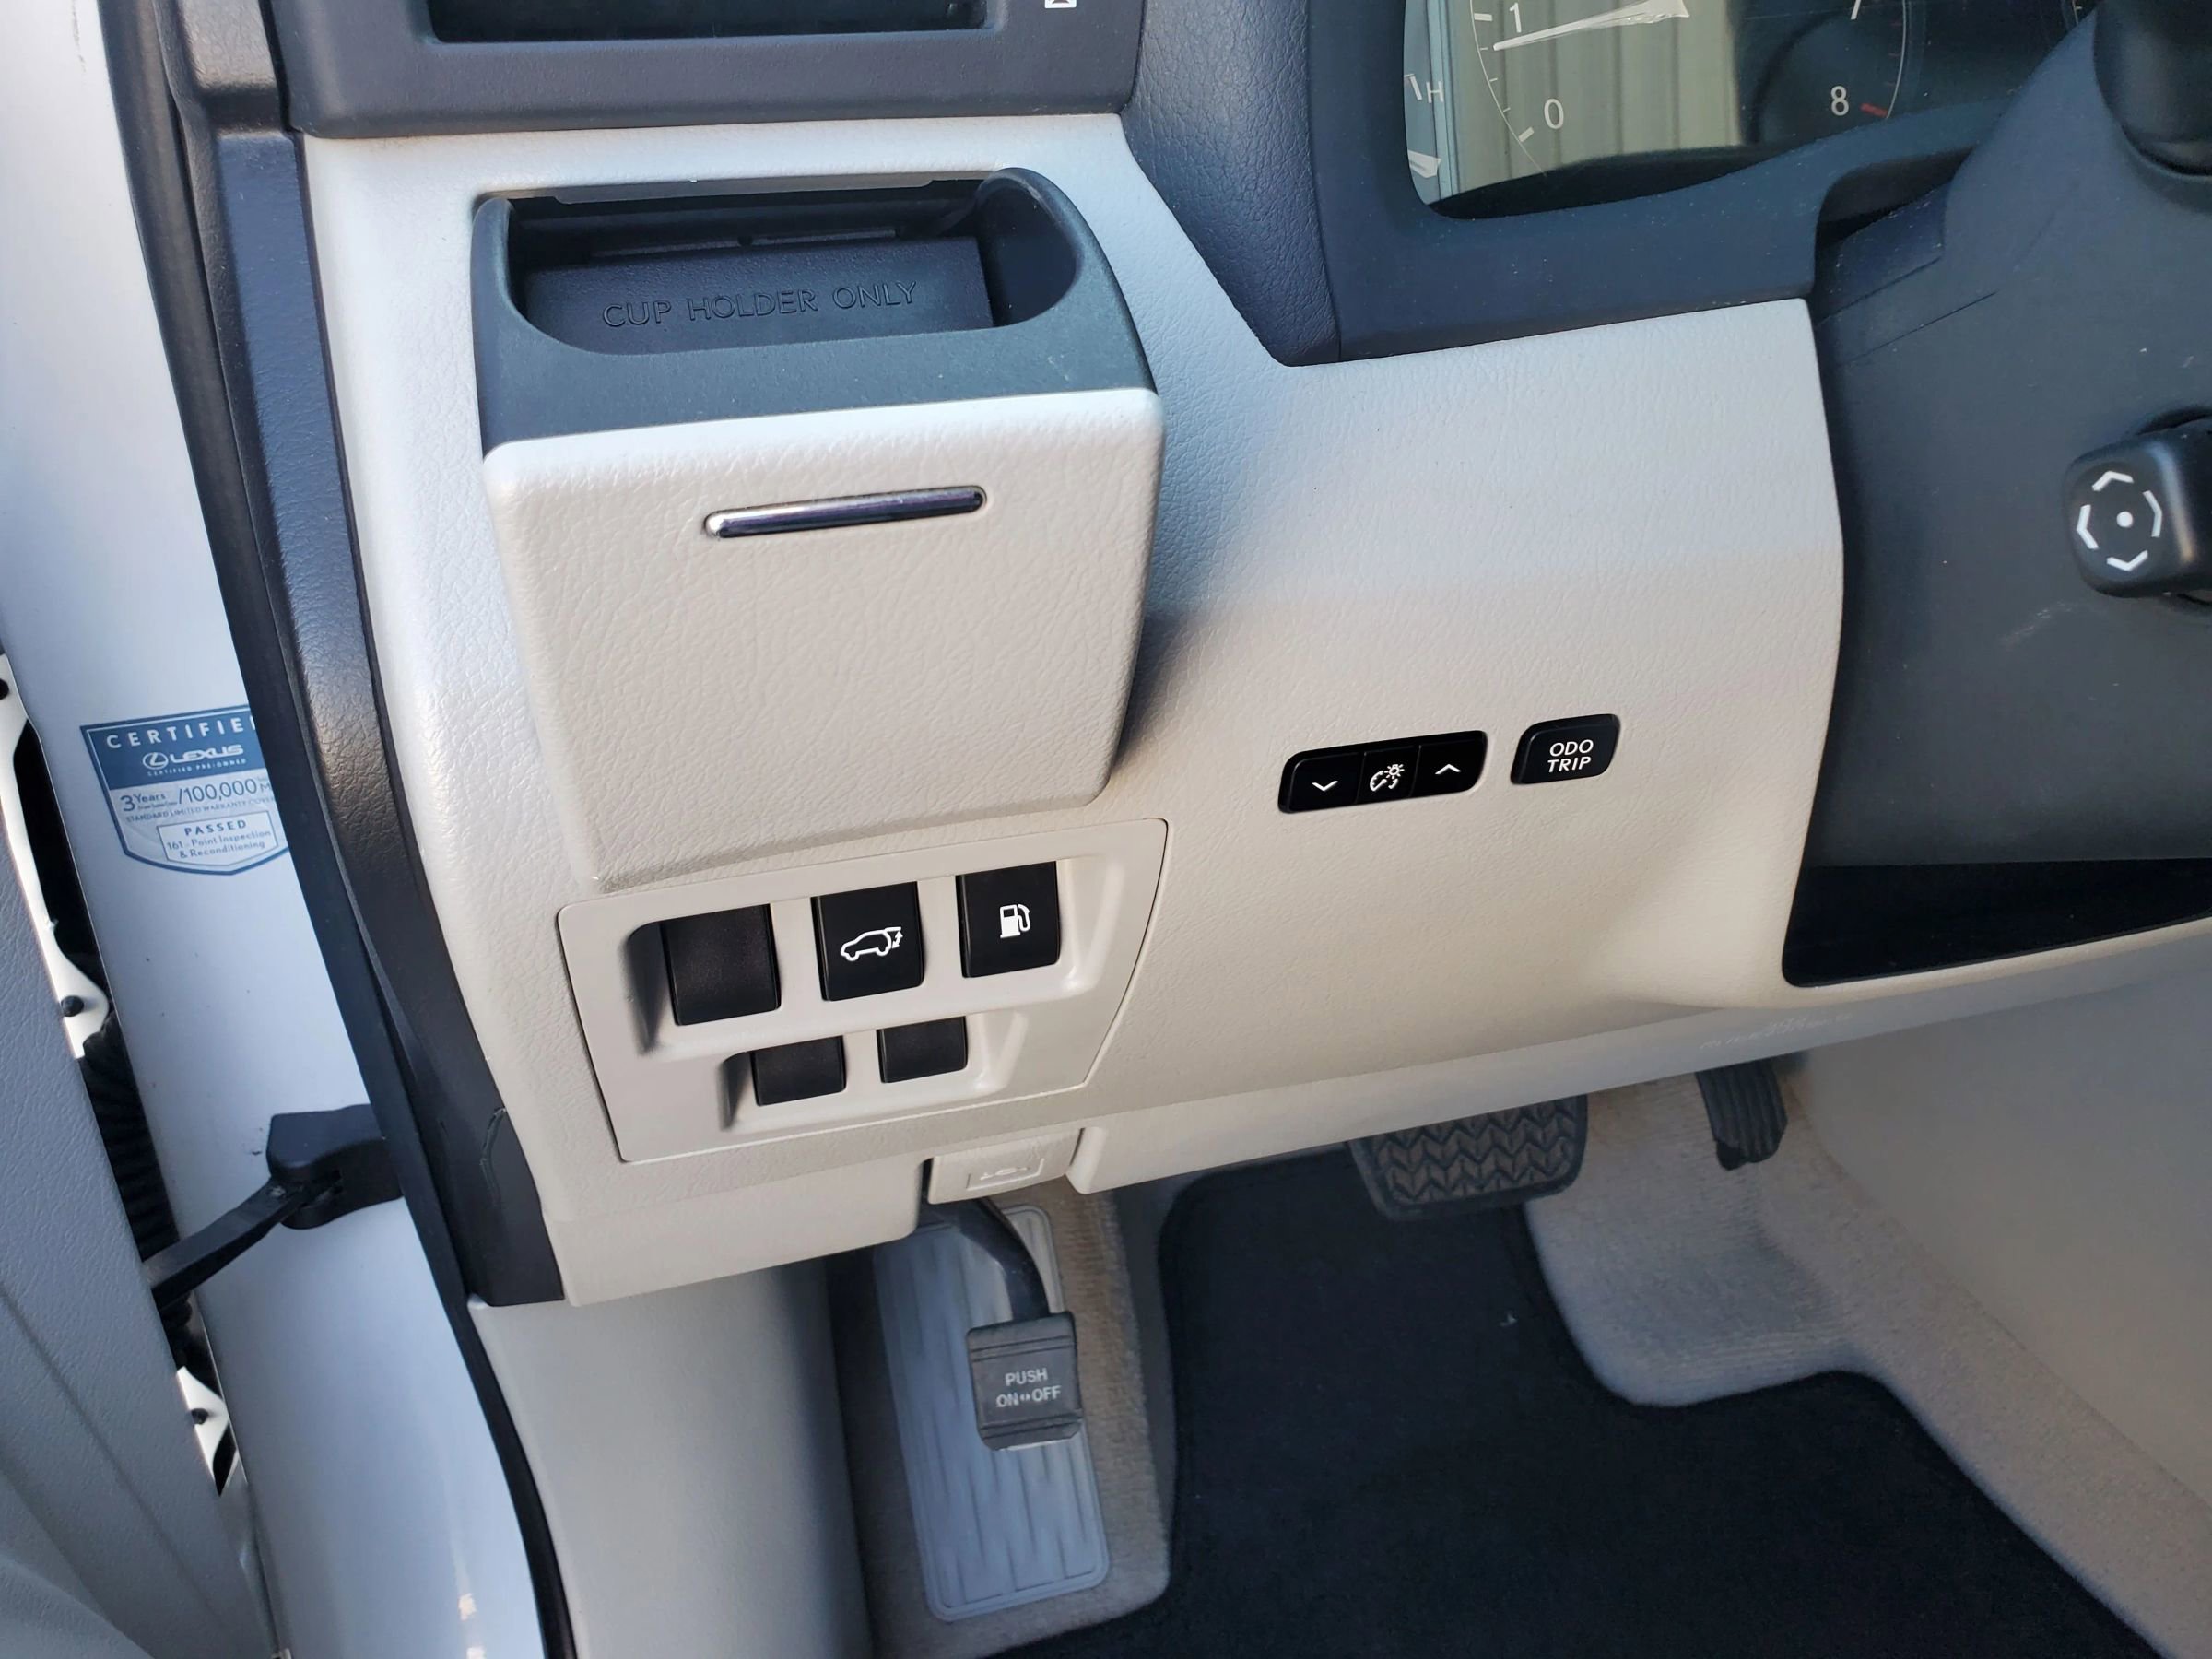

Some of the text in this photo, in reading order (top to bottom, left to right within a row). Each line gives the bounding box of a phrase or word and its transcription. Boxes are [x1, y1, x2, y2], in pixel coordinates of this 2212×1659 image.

[1509, 2, 1522, 33] 1
[1426, 80, 1444, 104] H
[1830, 85, 1850, 116] 8
[1544, 98, 1565, 130] 0
[602, 280, 918, 328] CUP HOLDER ONLY
[106, 715, 256, 749] CERTIFIE
[170, 744, 244, 763] LEXUS
[1549, 739, 1594, 757] ODO
[1547, 756, 1592, 773] TRIP
[121, 795, 135, 812] 3
[133, 793, 166, 805] Years
[125, 811, 171, 823] STANDARD
[203, 800, 247, 811] WARRANTY
[184, 819, 247, 837] PASSED
[167, 841, 183, 851] 161
[192, 838, 218, 847] Point
[218, 830, 272, 843] Inspection
[180, 841, 265, 858] & Reconditioning
[1005, 1368, 1048, 1386] PUSH
[996, 1384, 1062, 1407] ON OFF
